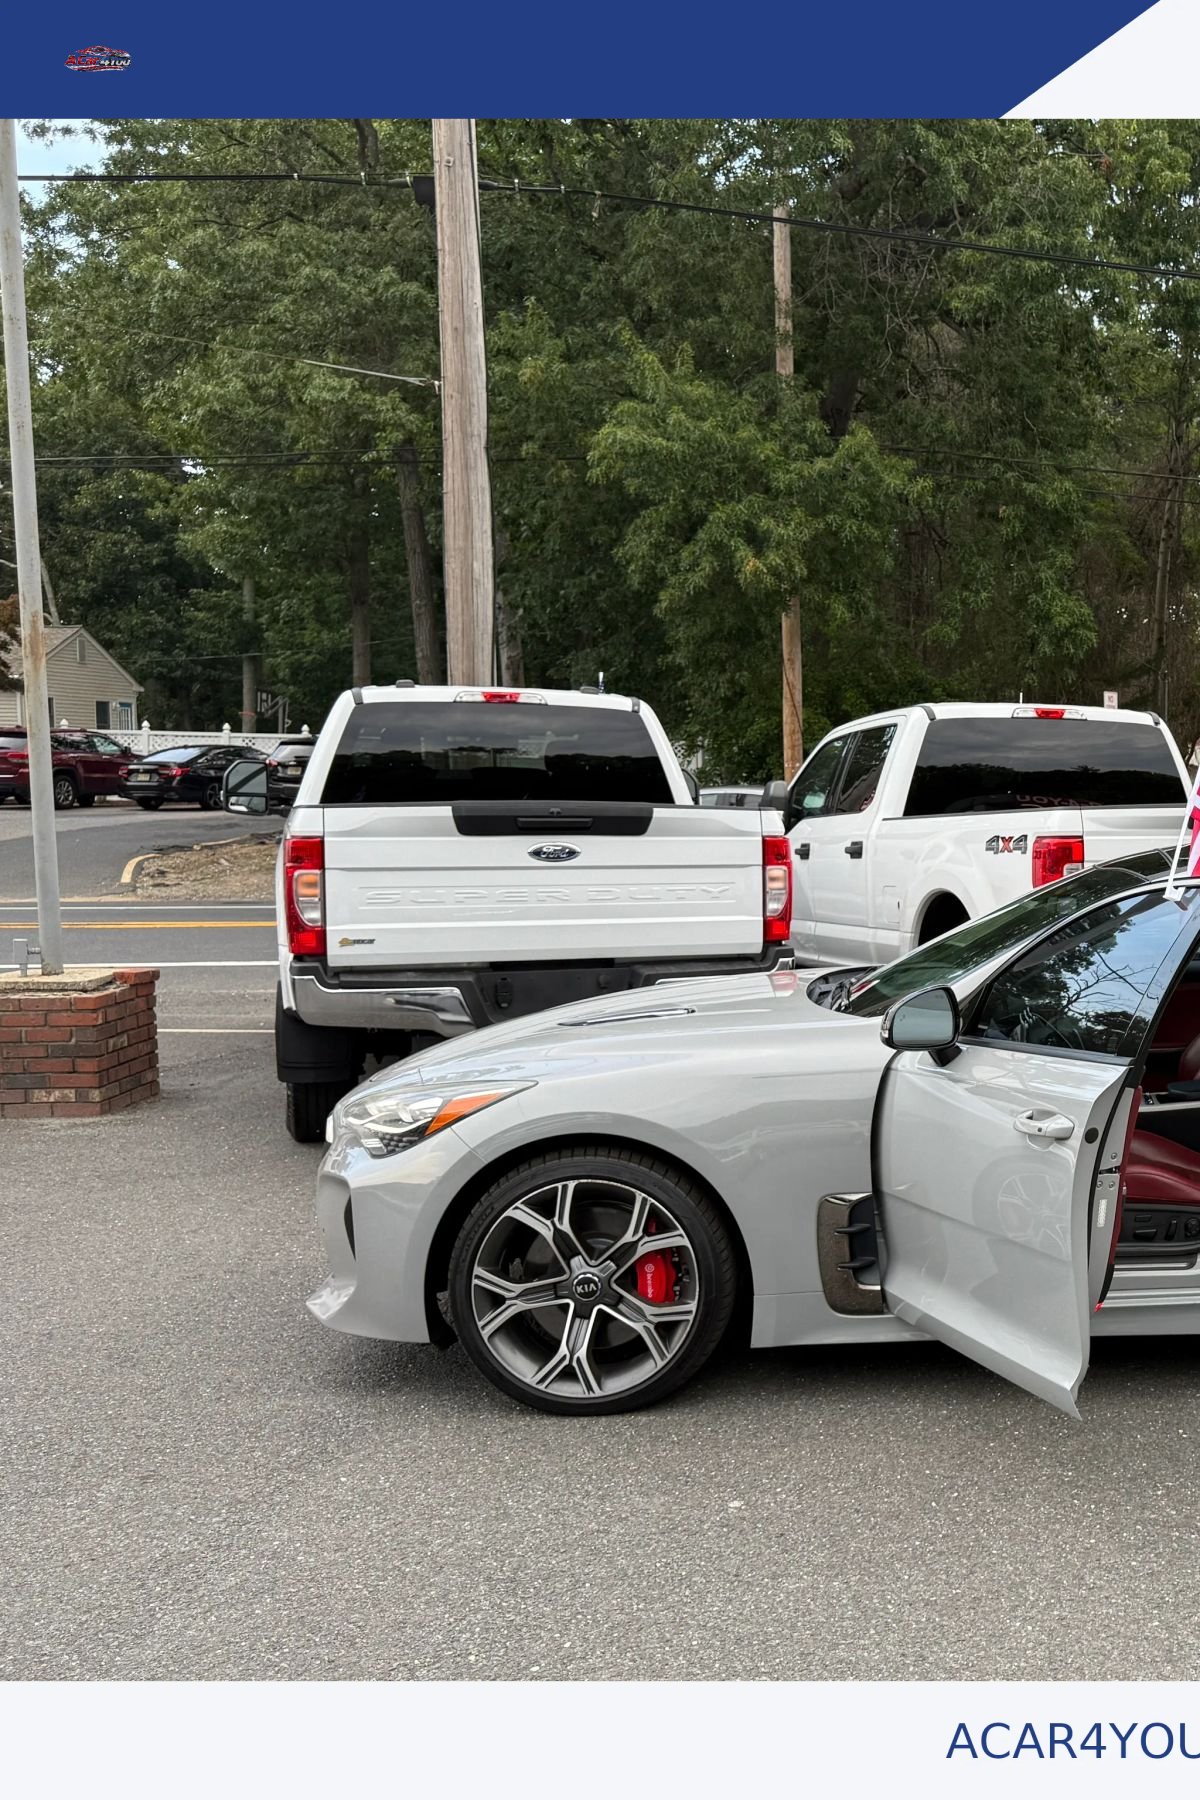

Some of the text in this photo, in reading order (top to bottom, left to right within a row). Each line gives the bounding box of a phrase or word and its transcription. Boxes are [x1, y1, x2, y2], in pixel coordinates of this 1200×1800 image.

[540, 846, 569, 858] Ford
[366, 886, 731, 905] SUPER DUTY
[576, 1283, 597, 1294] KIA
[646, 1273, 654, 1299] brembo
